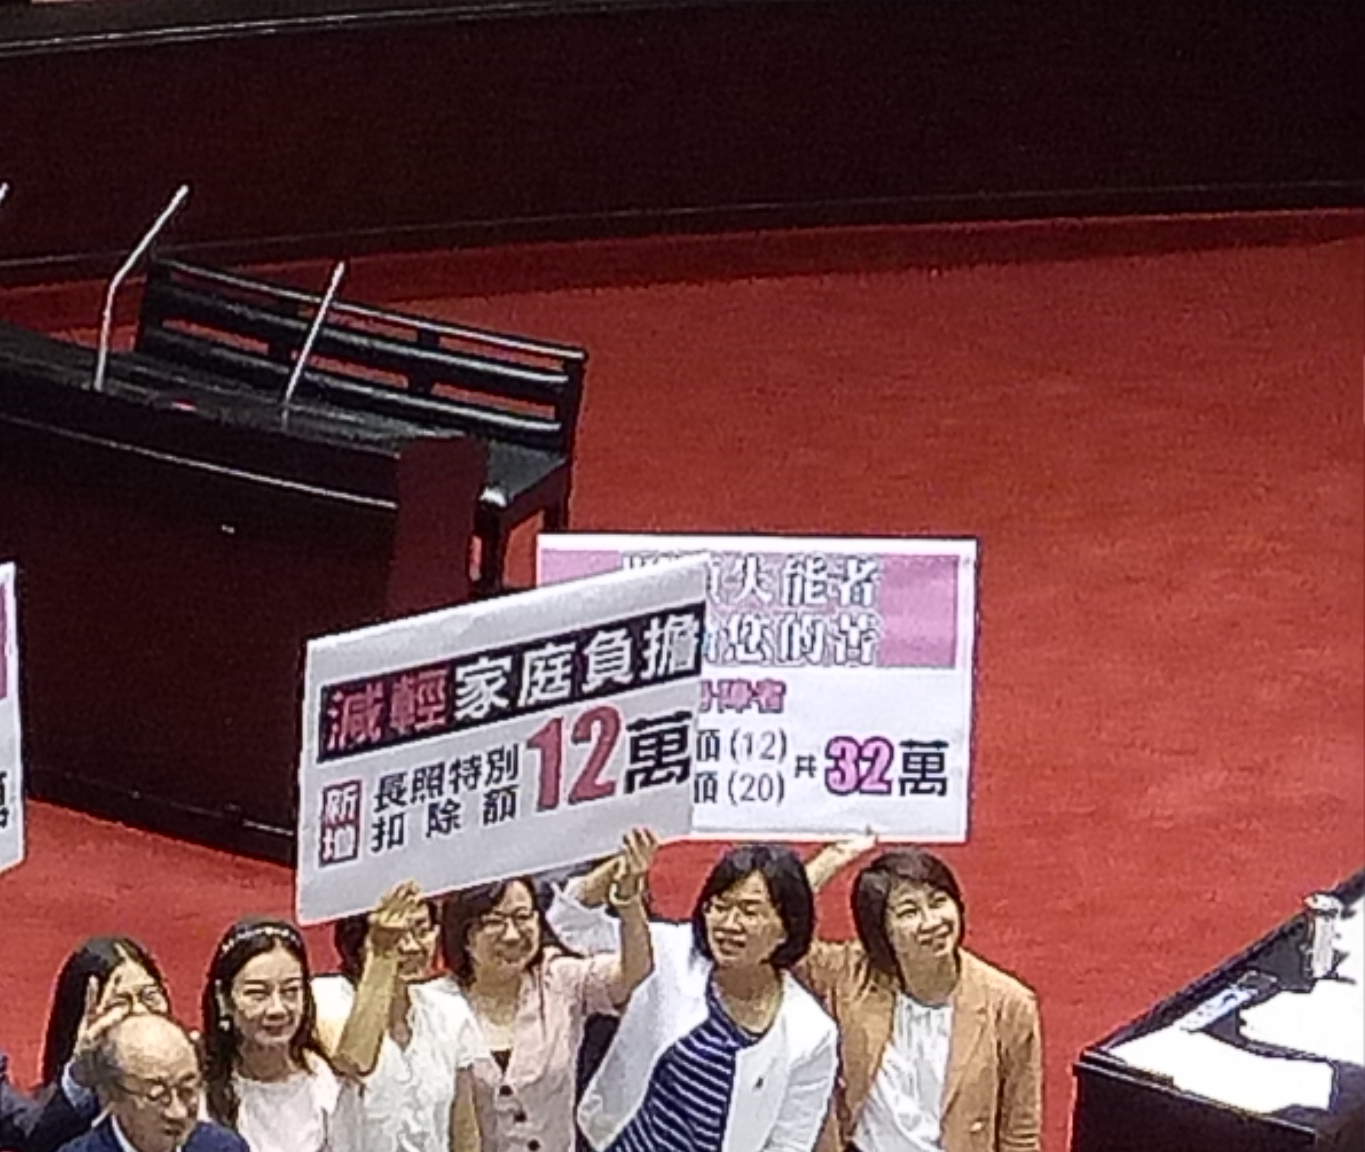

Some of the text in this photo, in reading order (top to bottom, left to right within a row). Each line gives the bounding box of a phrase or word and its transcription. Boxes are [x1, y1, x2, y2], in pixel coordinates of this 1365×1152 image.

[324, 615, 699, 752] 減輕家庭負擔
[373, 743, 519, 814] 長照特別
[528, 704, 692, 812] 12萬
[323, 786, 360, 862] 新增
[370, 784, 518, 853] 扣除額
